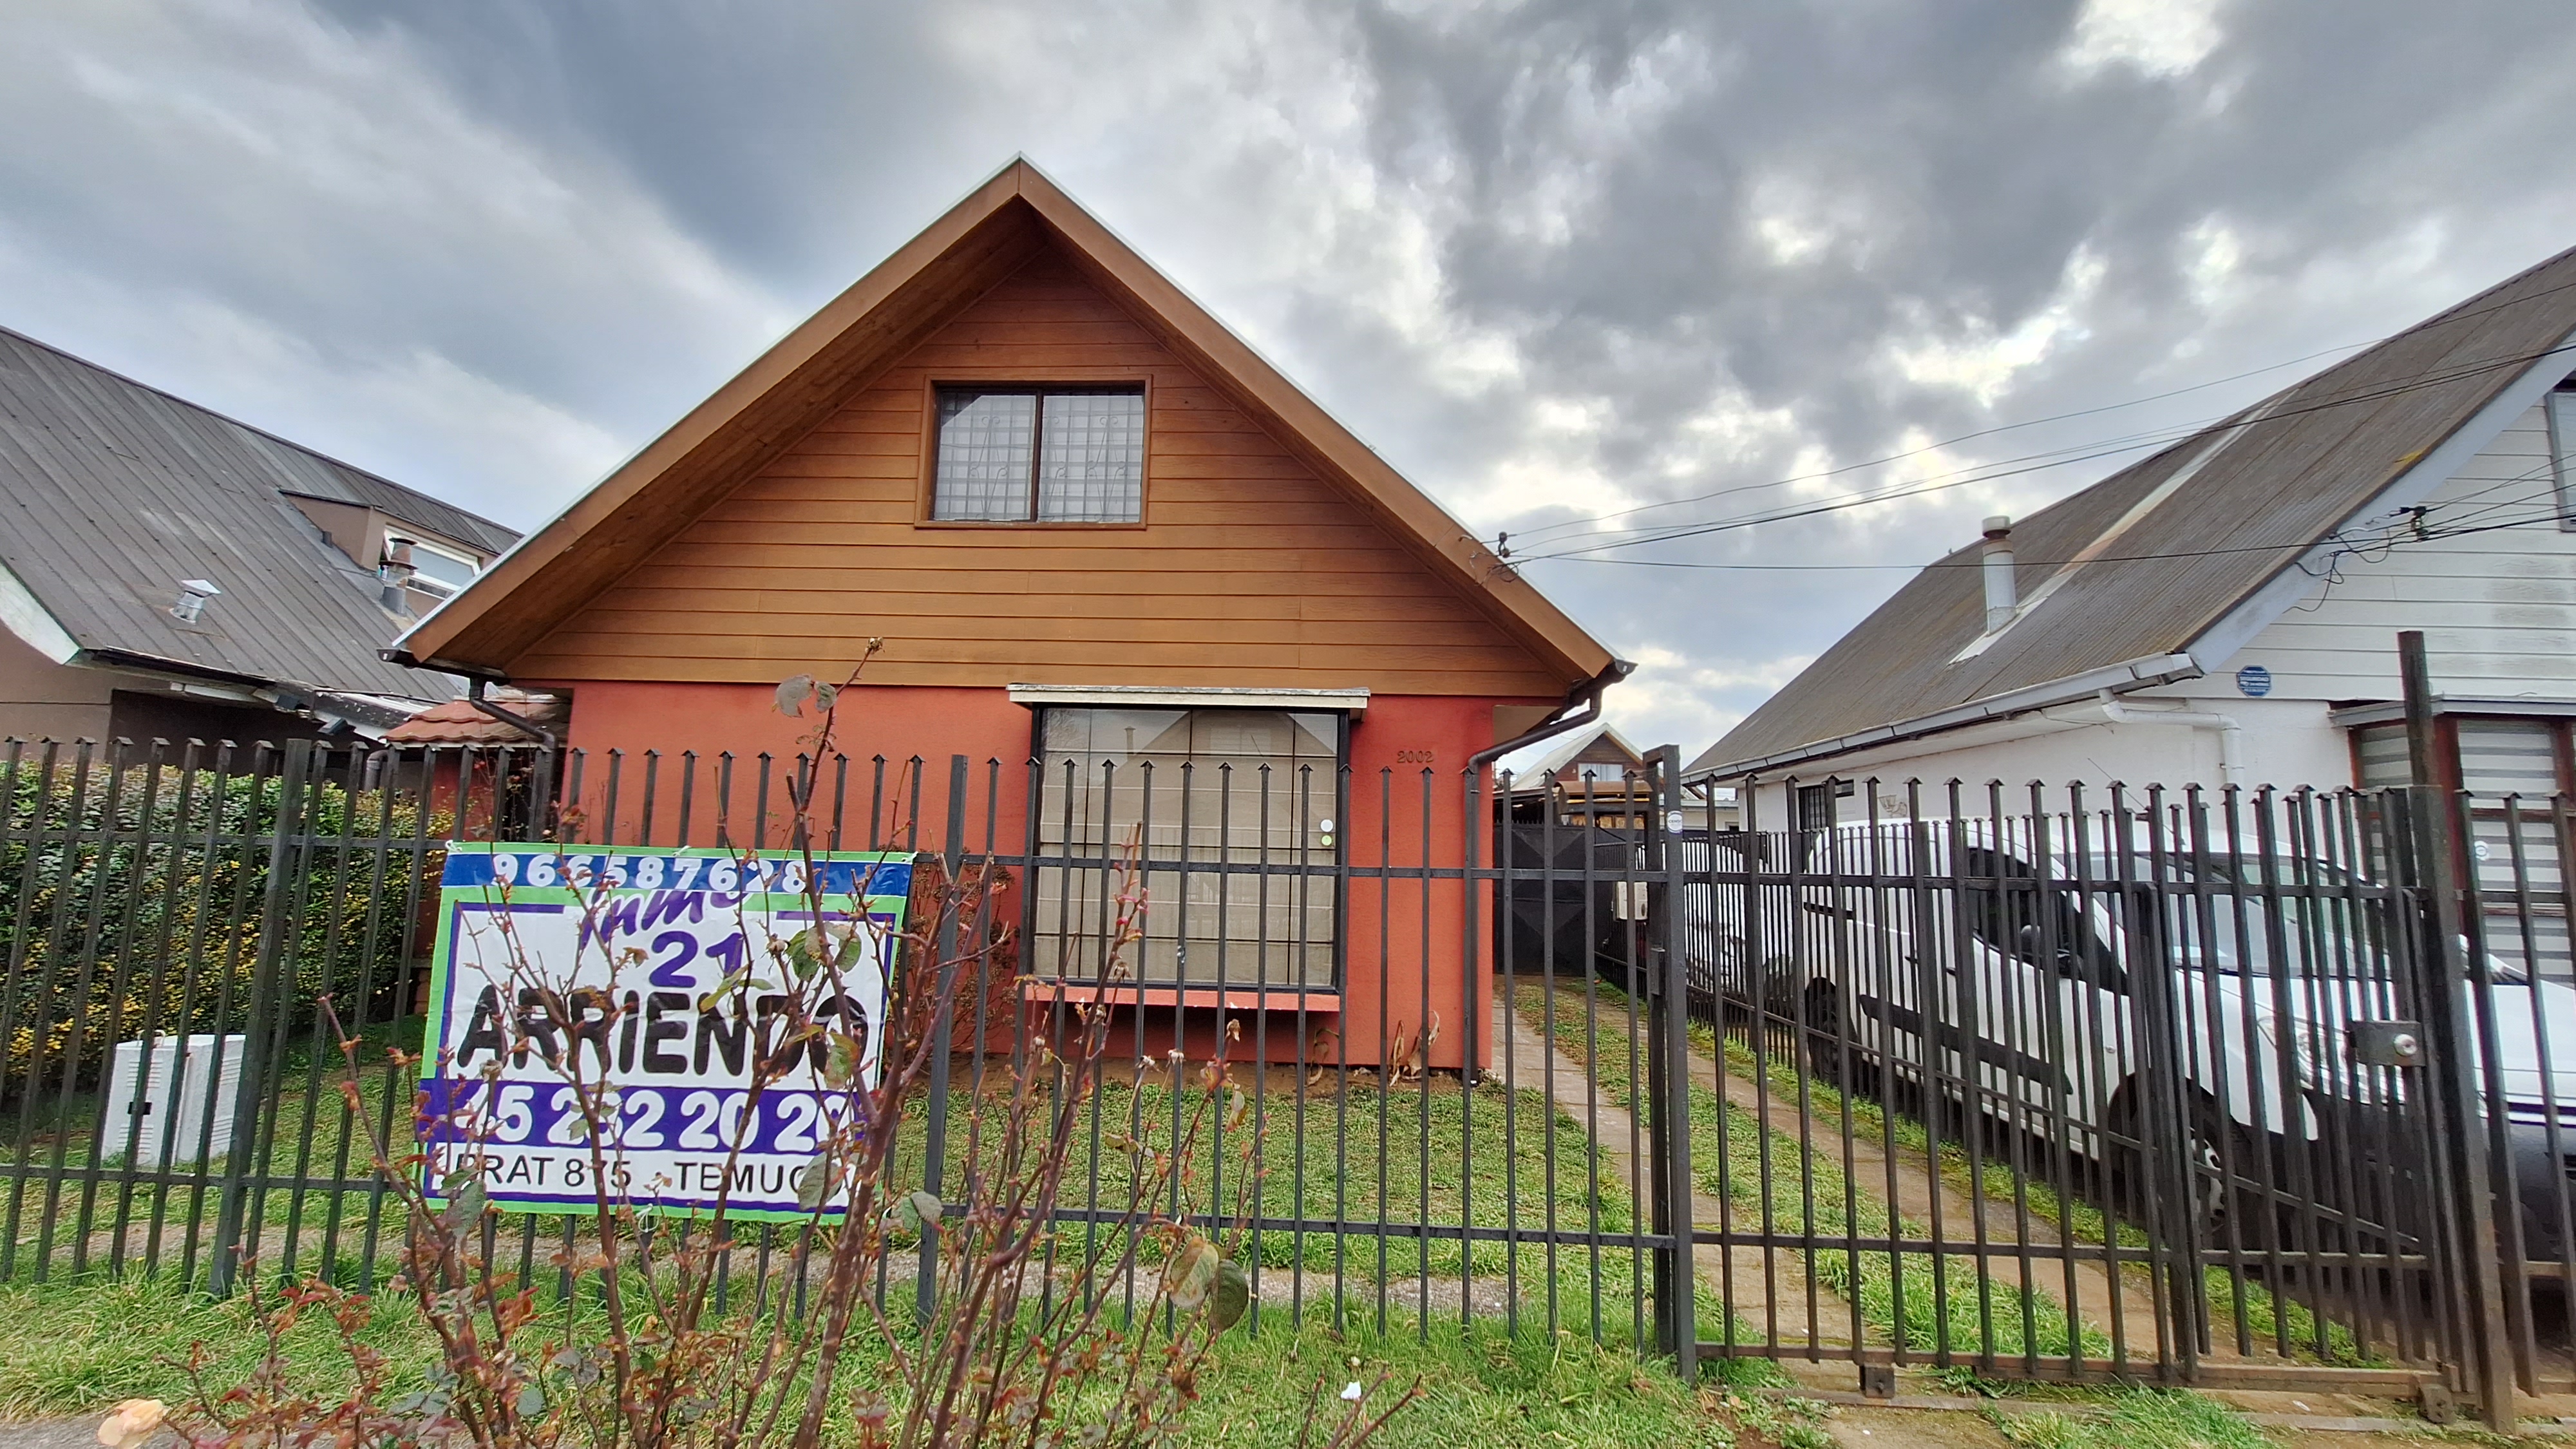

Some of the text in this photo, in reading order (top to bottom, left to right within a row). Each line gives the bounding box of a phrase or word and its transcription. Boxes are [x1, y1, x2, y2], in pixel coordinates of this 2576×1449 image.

[1396, 750, 1434, 763] 2002
[492, 853, 807, 893] 966587628
[649, 931, 744, 988] 21
[457, 985, 868, 1077] ARRIENDO
[678, 1090, 760, 1151] 20
[773, 1093, 855, 1153] 20
[674, 1161, 842, 1196] TEMUC
